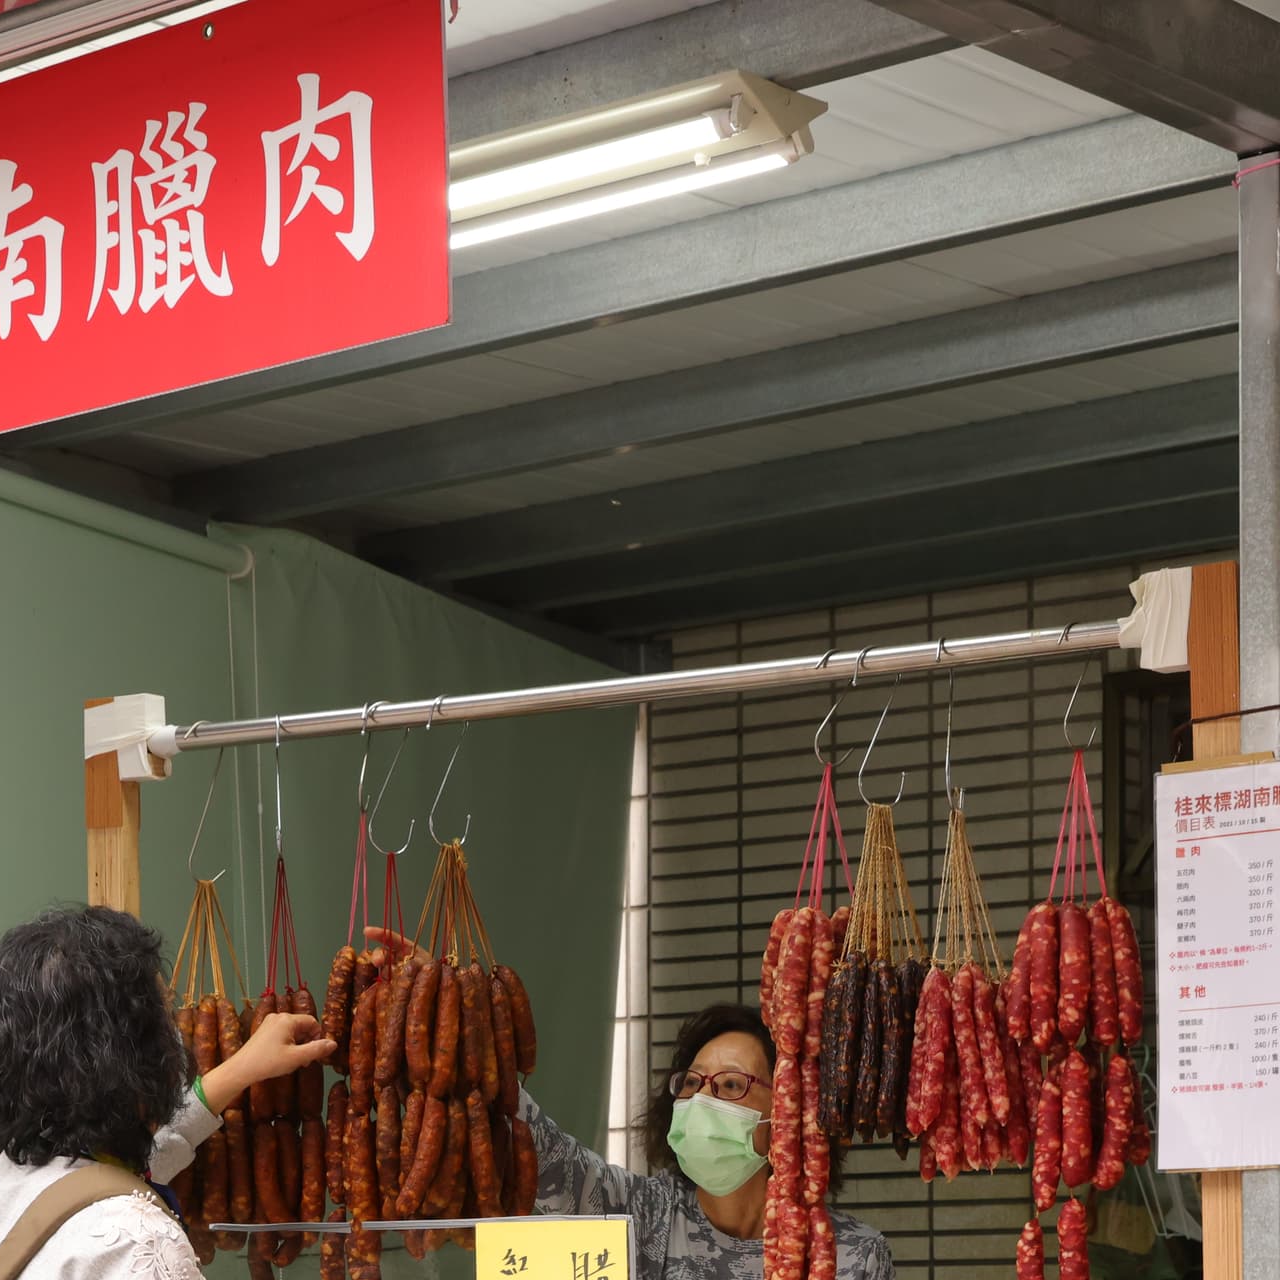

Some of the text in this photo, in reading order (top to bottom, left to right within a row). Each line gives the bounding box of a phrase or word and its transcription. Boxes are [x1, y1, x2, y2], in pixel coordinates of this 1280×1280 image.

[1175, 816, 1216, 833] 價目表
[1179, 985, 1207, 999] 其他
